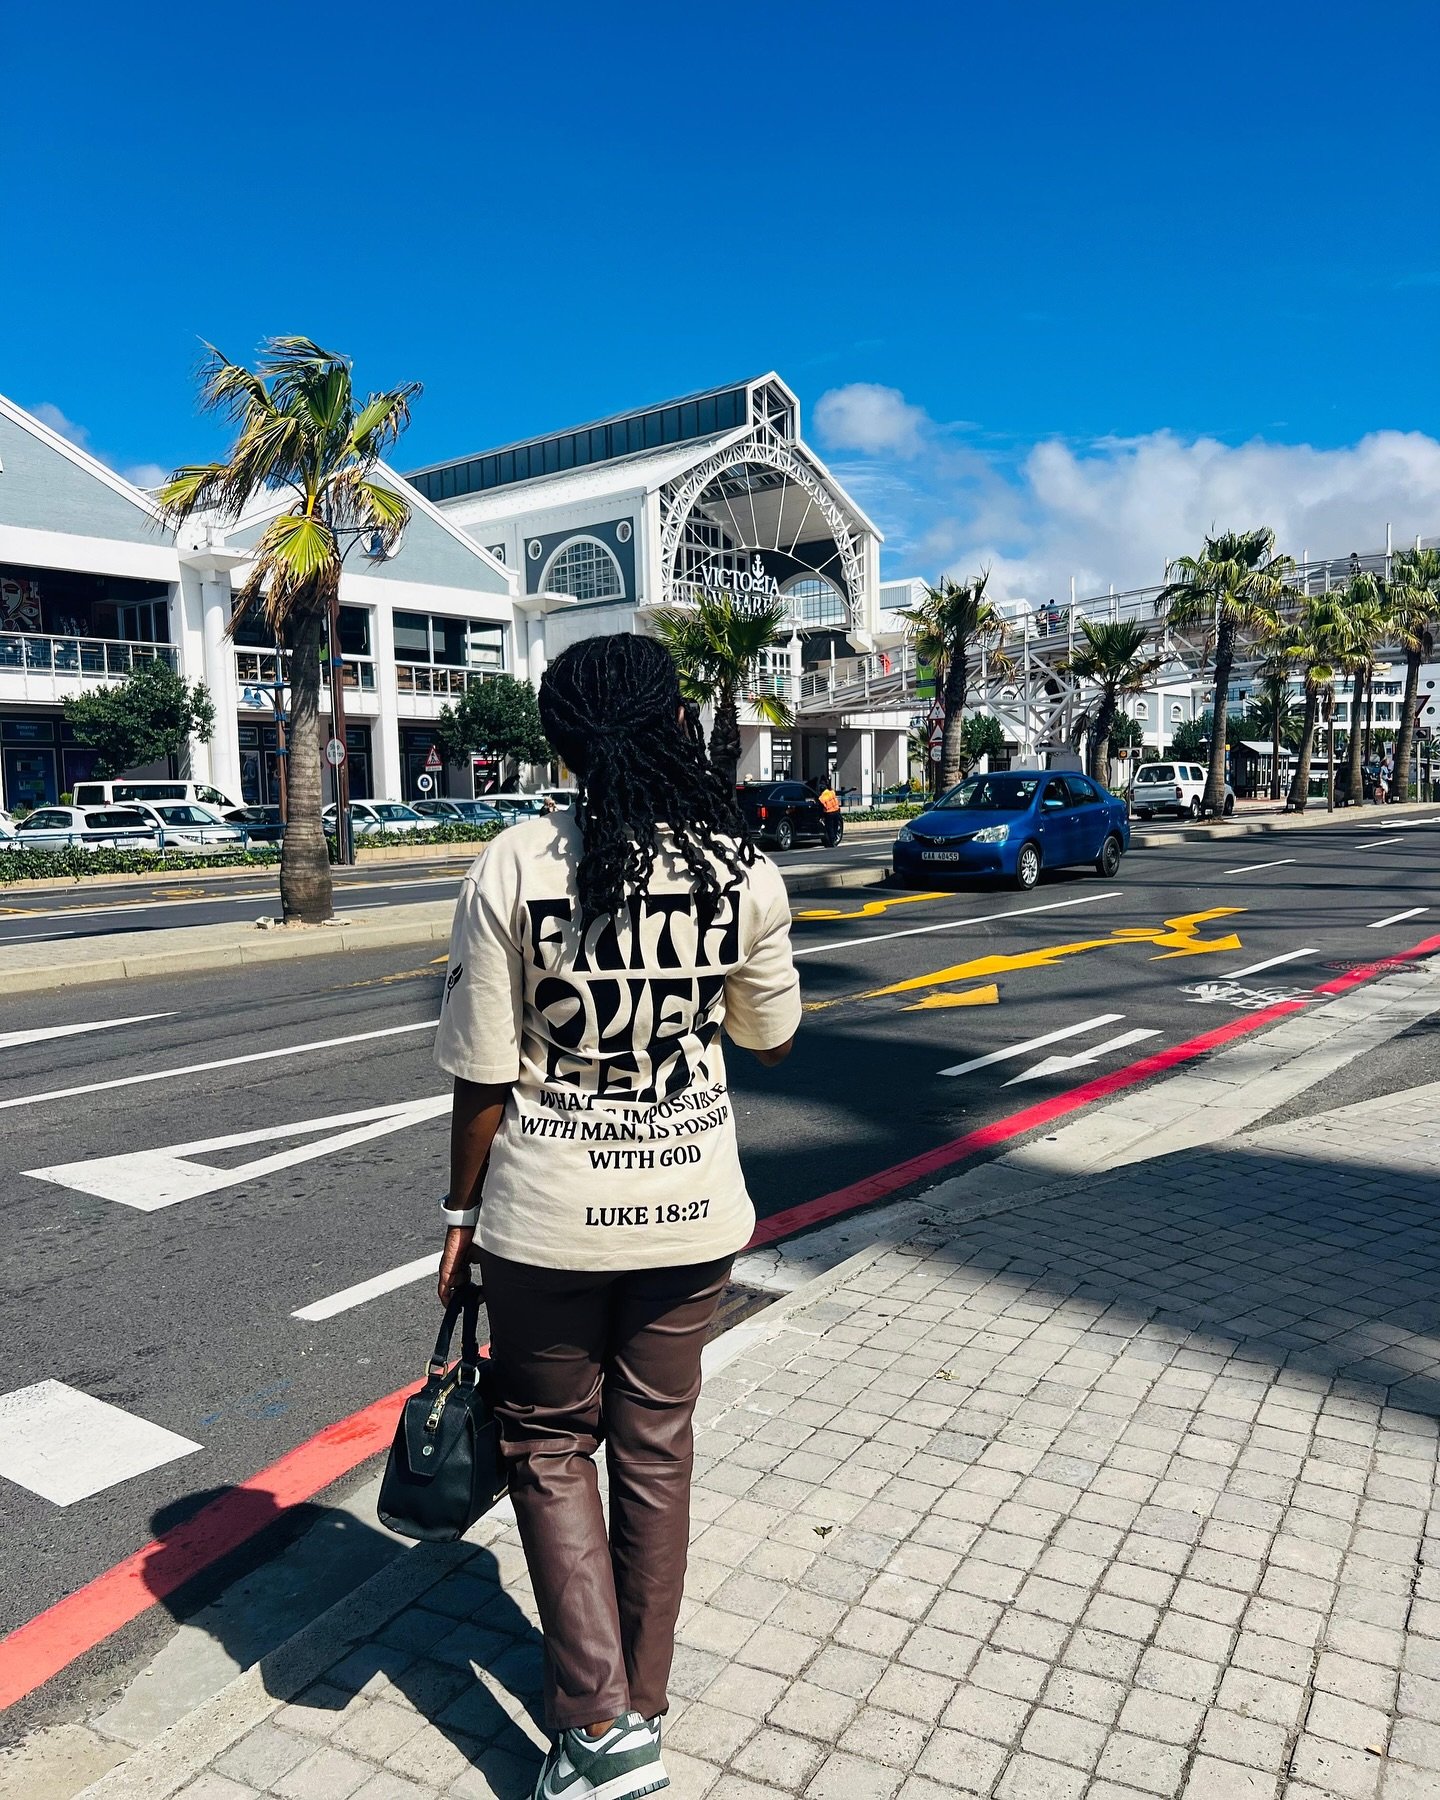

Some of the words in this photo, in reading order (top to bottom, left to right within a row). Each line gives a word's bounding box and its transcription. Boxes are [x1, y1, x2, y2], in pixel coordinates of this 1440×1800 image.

[701, 565, 779, 596] VICTORIA
[526, 891, 740, 973] FAITH
[534, 974, 727, 1053] OVER
[540, 1089, 594, 1111] WHAT
[623, 1083, 727, 1125] IMPOSSIBLE
[520, 1115, 577, 1140] WITH
[580, 1121, 644, 1144] MAN,
[647, 1124, 670, 1140] IS
[672, 1105, 728, 1136] POSSIB
[588, 1150, 654, 1170] WITH
[660, 1144, 701, 1167] GOD
[585, 1206, 649, 1227] LUKE
[655, 1198, 710, 1224] 18:27
